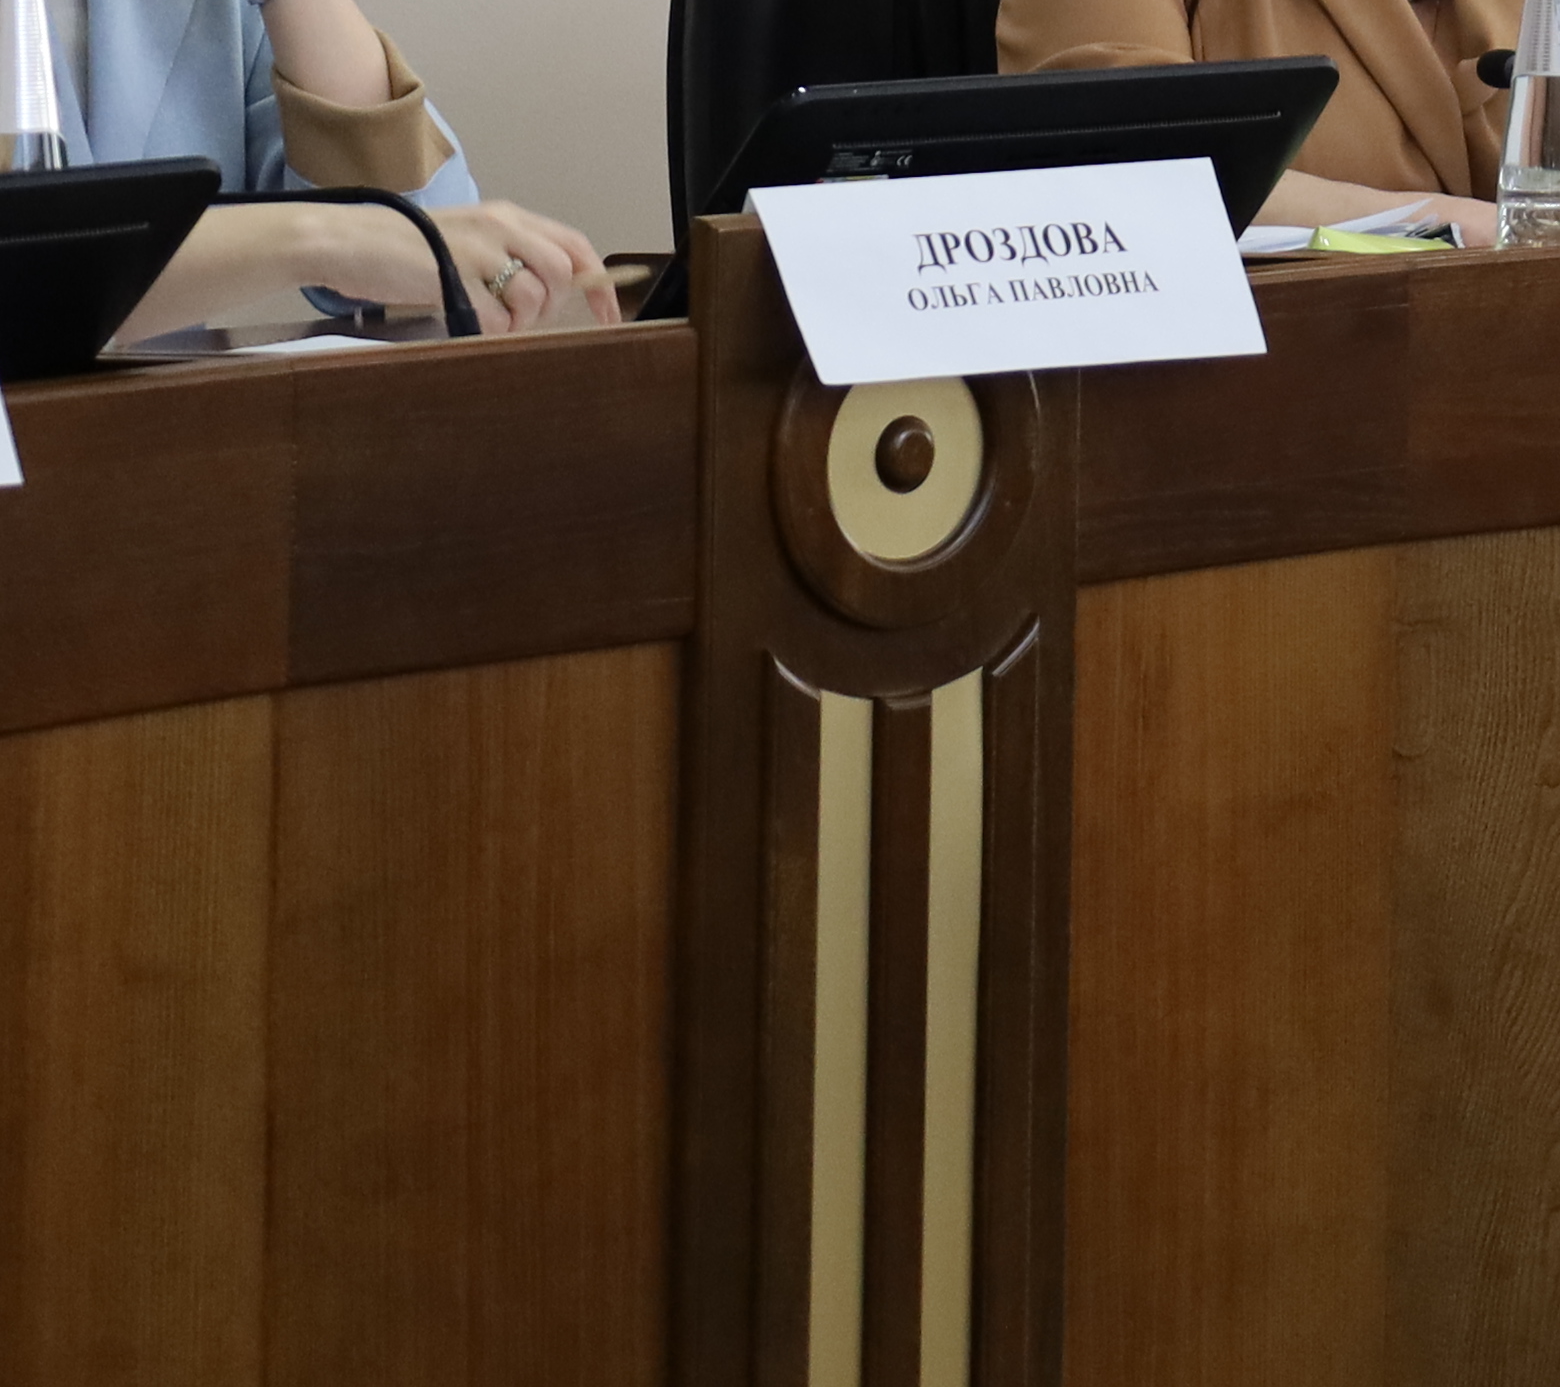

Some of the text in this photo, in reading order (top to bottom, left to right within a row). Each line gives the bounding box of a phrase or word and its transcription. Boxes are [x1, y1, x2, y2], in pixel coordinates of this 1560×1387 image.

[912, 220, 1129, 275] ДРОЗДОВА
[906, 270, 1161, 312] ОЛЬГА ПАВЛОВНА
